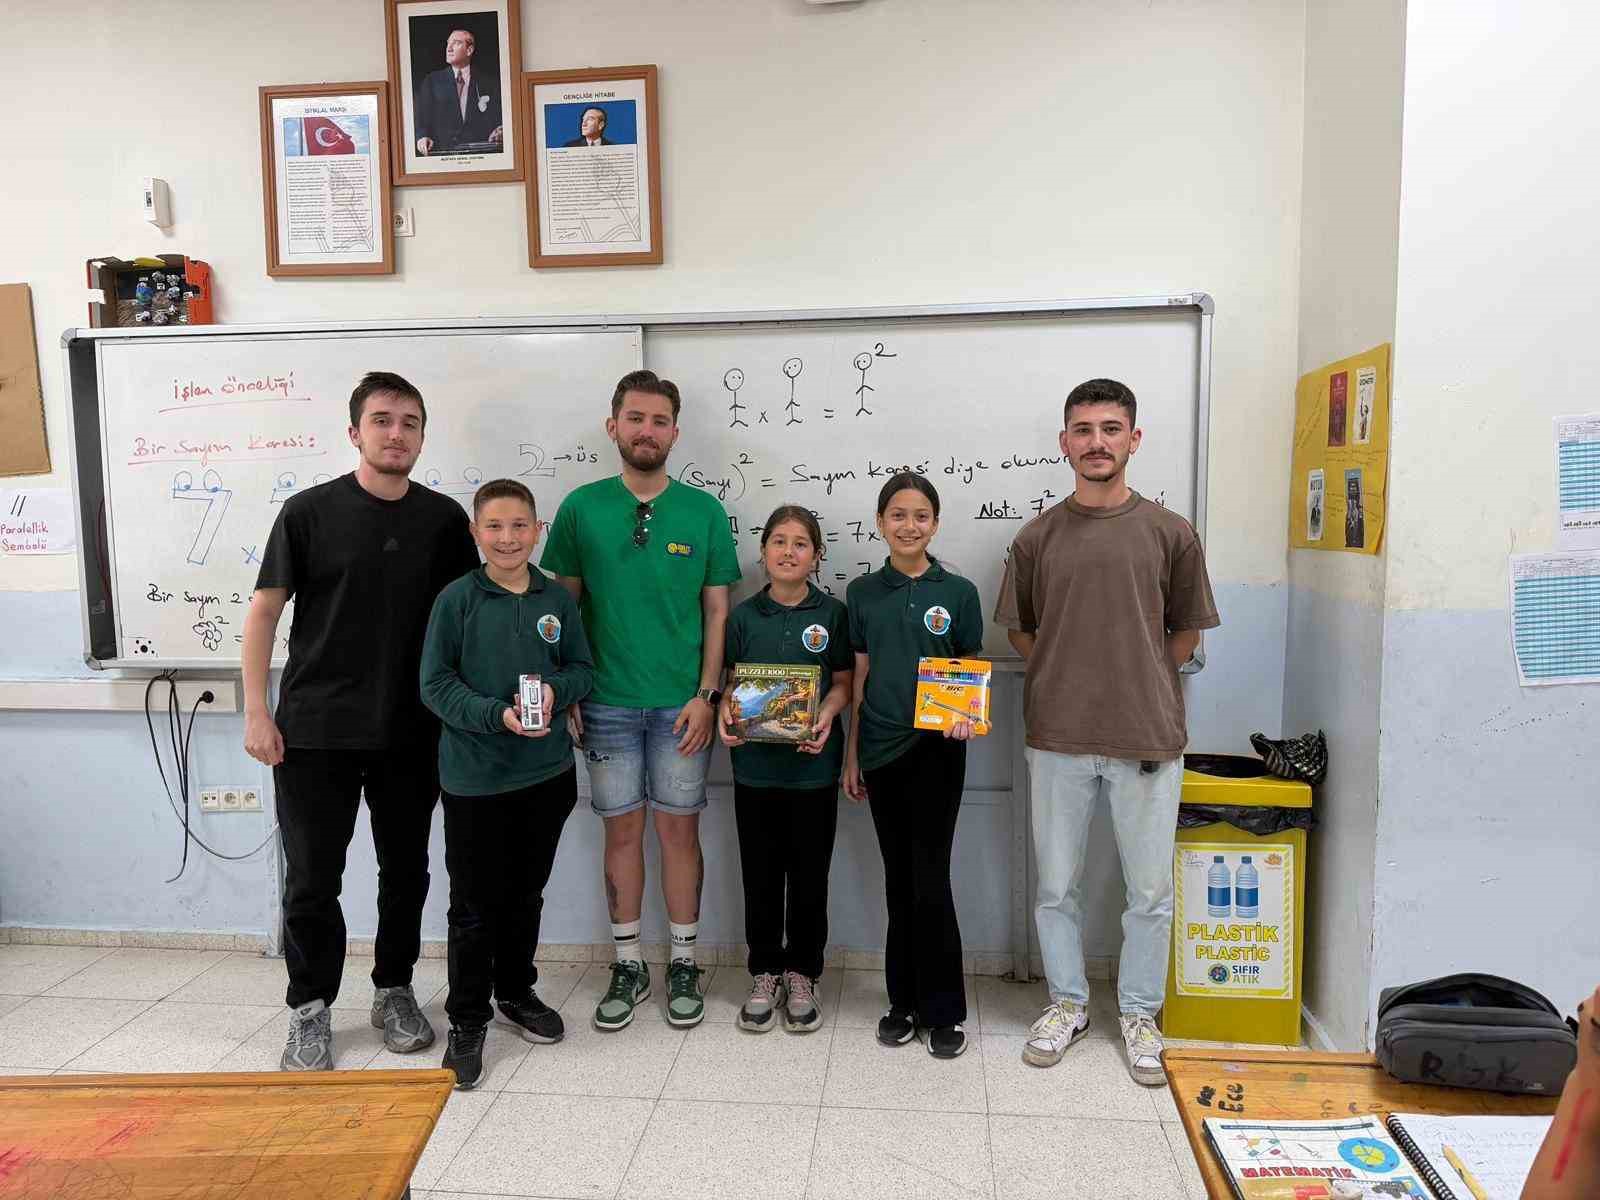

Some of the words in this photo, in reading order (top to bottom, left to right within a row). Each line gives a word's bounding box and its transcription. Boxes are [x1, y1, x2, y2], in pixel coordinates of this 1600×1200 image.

[944, 457, 988, 484] diye
[978, 500, 1017, 518] Not:
[147, 583, 174, 602] Bir
[1187, 922, 1280, 942] PLASTİK
[1232, 965, 1260, 974] SIFIR
[1233, 974, 1260, 984] ATIK
[1240, 1165, 1357, 1179] MATEMATİK
